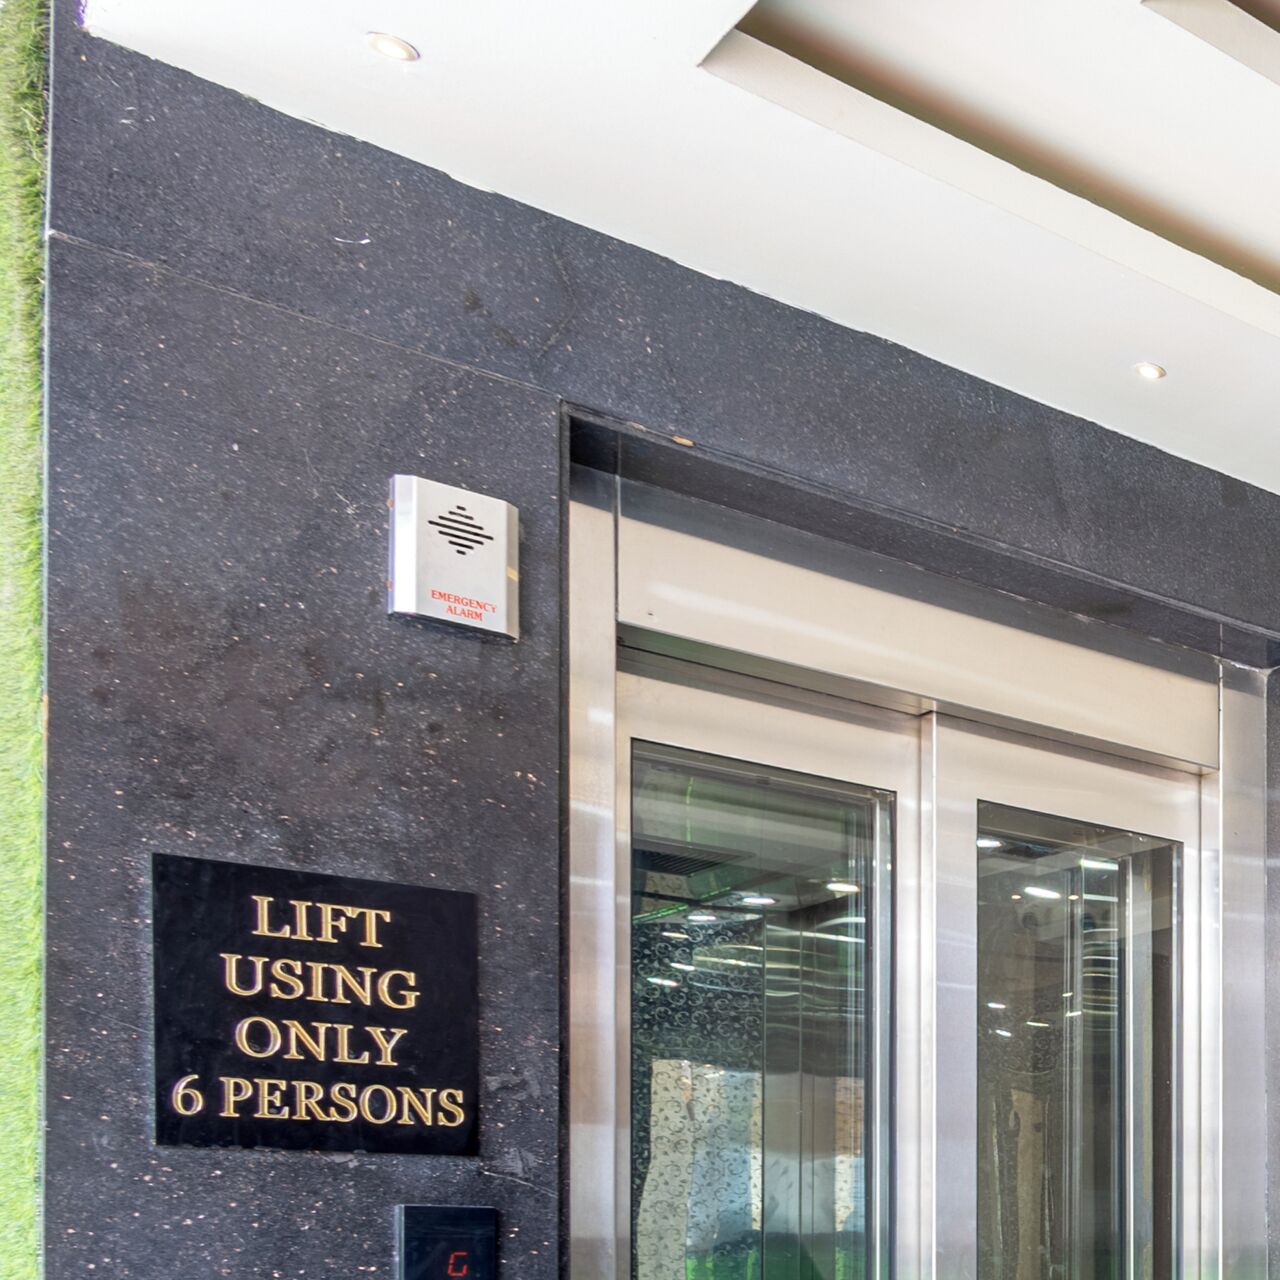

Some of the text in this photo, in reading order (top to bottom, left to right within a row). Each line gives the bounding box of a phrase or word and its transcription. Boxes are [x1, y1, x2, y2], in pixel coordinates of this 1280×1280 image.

[431, 589, 497, 613] EMERGENCY
[446, 605, 483, 621] ALARM
[251, 895, 391, 948] LIFT
[220, 953, 420, 1010] USING
[235, 1016, 407, 1067] ONLY
[172, 1073, 465, 1128] 6 PERSONS
[447, 1251, 468, 1277] G
